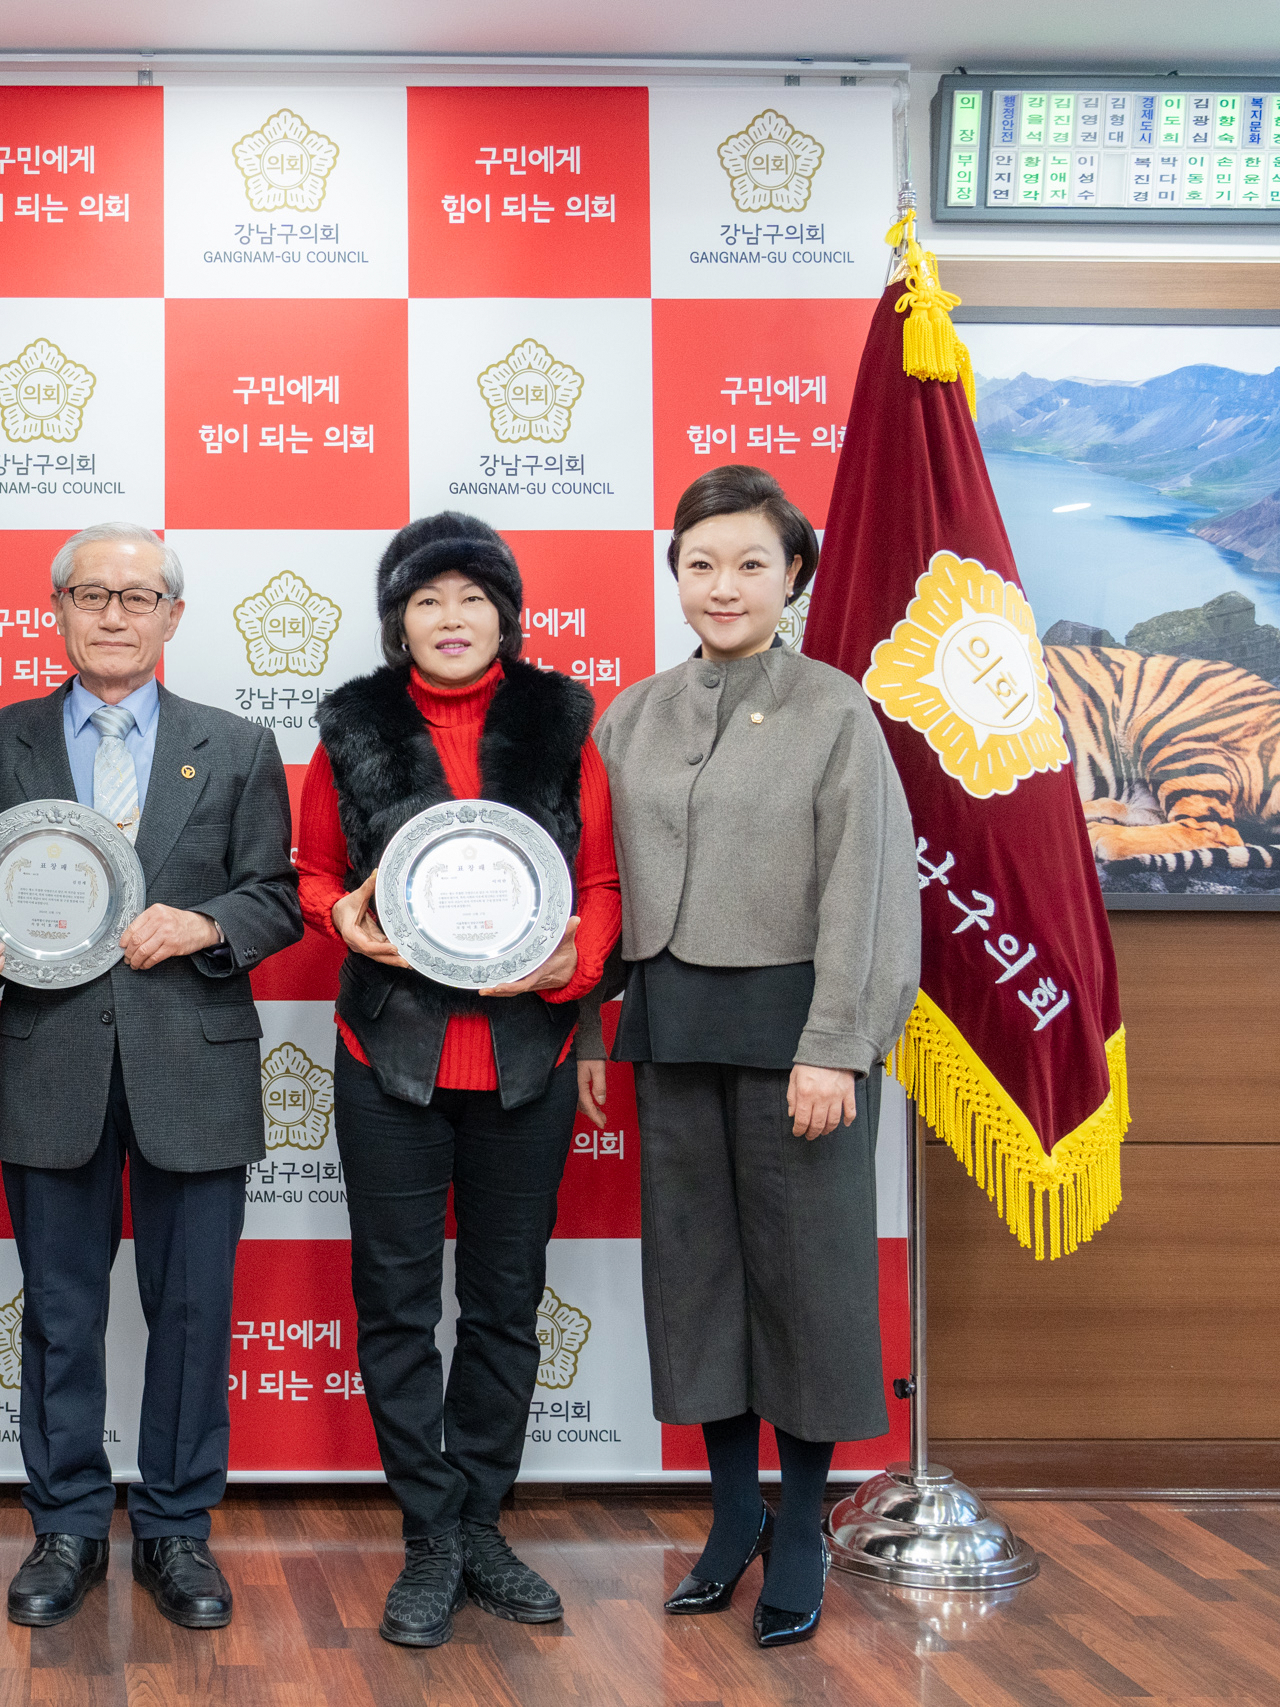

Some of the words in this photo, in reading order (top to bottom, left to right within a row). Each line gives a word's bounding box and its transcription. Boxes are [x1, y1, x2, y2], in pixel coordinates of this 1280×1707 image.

[1001, 95, 1016, 142] 행정안전
[1027, 97, 1044, 142] 강을석
[1053, 98, 1070, 143] 김진경
[1081, 98, 1098, 142] 김영권
[1109, 98, 1126, 142] 김형대
[1139, 97, 1154, 143] 경제도시
[1164, 99, 1180, 143] 이도희
[1192, 99, 1209, 143] 김광심
[1218, 99, 1236, 143] 이향숙
[1249, 98, 1263, 144] 복지문화
[267, 154, 304, 174] 의회
[475, 145, 581, 174] 구민에게
[752, 154, 789, 174] 의회
[957, 154, 972, 200] 부의장
[993, 156, 1012, 199] 안지연
[1023, 157, 1041, 200] 황영각
[1050, 156, 1068, 199] 노애자
[1077, 157, 1094, 200] 이성수
[1133, 158, 1151, 201] 복진경
[1159, 157, 1178, 201] 박다미
[1186, 157, 1204, 200] 이동호
[1216, 157, 1233, 200] 손민기
[1242, 157, 1261, 201] 한윤수
[15, 193, 68, 222] 되는
[79, 193, 129, 222] 의회
[442, 193, 490, 222] 힘이
[501, 193, 554, 222] 되는
[565, 193, 616, 222] 의회
[234, 223, 339, 244] 강남구의회
[720, 224, 824, 244] 강남구의회
[203, 251, 301, 263] GANGNAM-GU
[306, 251, 368, 263] COUNCIL
[690, 251, 786, 263] GANGNAM-GU
[792, 251, 854, 263] COUNCIL
[22, 385, 61, 405] 의회
[233, 376, 340, 405] 구민에게
[512, 385, 549, 405] 의회
[720, 376, 827, 405] 구민에게
[199, 424, 248, 454] 힘이
[259, 424, 312, 454] 되는
[324, 424, 375, 454] 의회
[687, 424, 736, 454] 힘이
[747, 424, 800, 454] 되는
[480, 454, 585, 476] 강남구의회
[62, 482, 125, 494] COUNCIL
[449, 482, 546, 494] GANGNAM-GU
[552, 482, 614, 494] COUNCIL
[268, 618, 306, 638] 의회
[776, 616, 795, 638] 회
[13, 656, 68, 687] 되는
[571, 657, 620, 686] 의회
[957, 636, 1029, 720] 의회
[916, 836, 1070, 1032] 남구의회
[268, 1089, 306, 1111] 의회
[574, 1130, 624, 1160] 의회
[245, 1191, 303, 1204] NAM-GU
[308, 1191, 348, 1204] COUN
[232, 1320, 340, 1350] 구민에게
[538, 1328, 554, 1350] 회
[229, 1370, 246, 1400] 이
[258, 1370, 313, 1401] 되는
[528, 1400, 591, 1422] 구의회
[558, 1430, 620, 1442] COUNCIL
